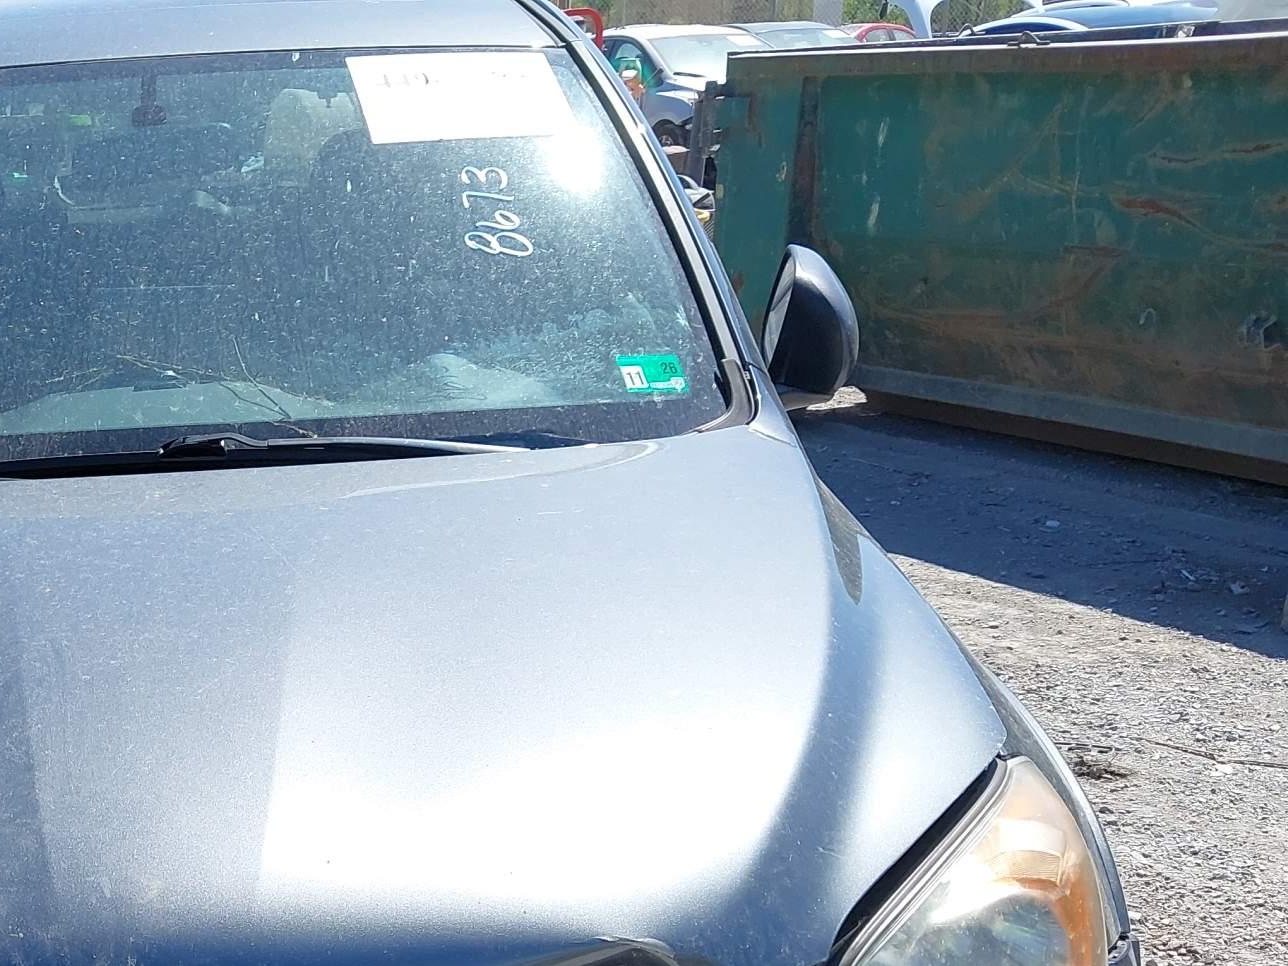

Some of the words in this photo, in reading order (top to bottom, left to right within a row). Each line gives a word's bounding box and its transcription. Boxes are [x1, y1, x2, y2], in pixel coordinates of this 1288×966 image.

[461, 166, 534, 257] 8673
[660, 362, 678, 374] 26
[625, 370, 645, 386] 11
